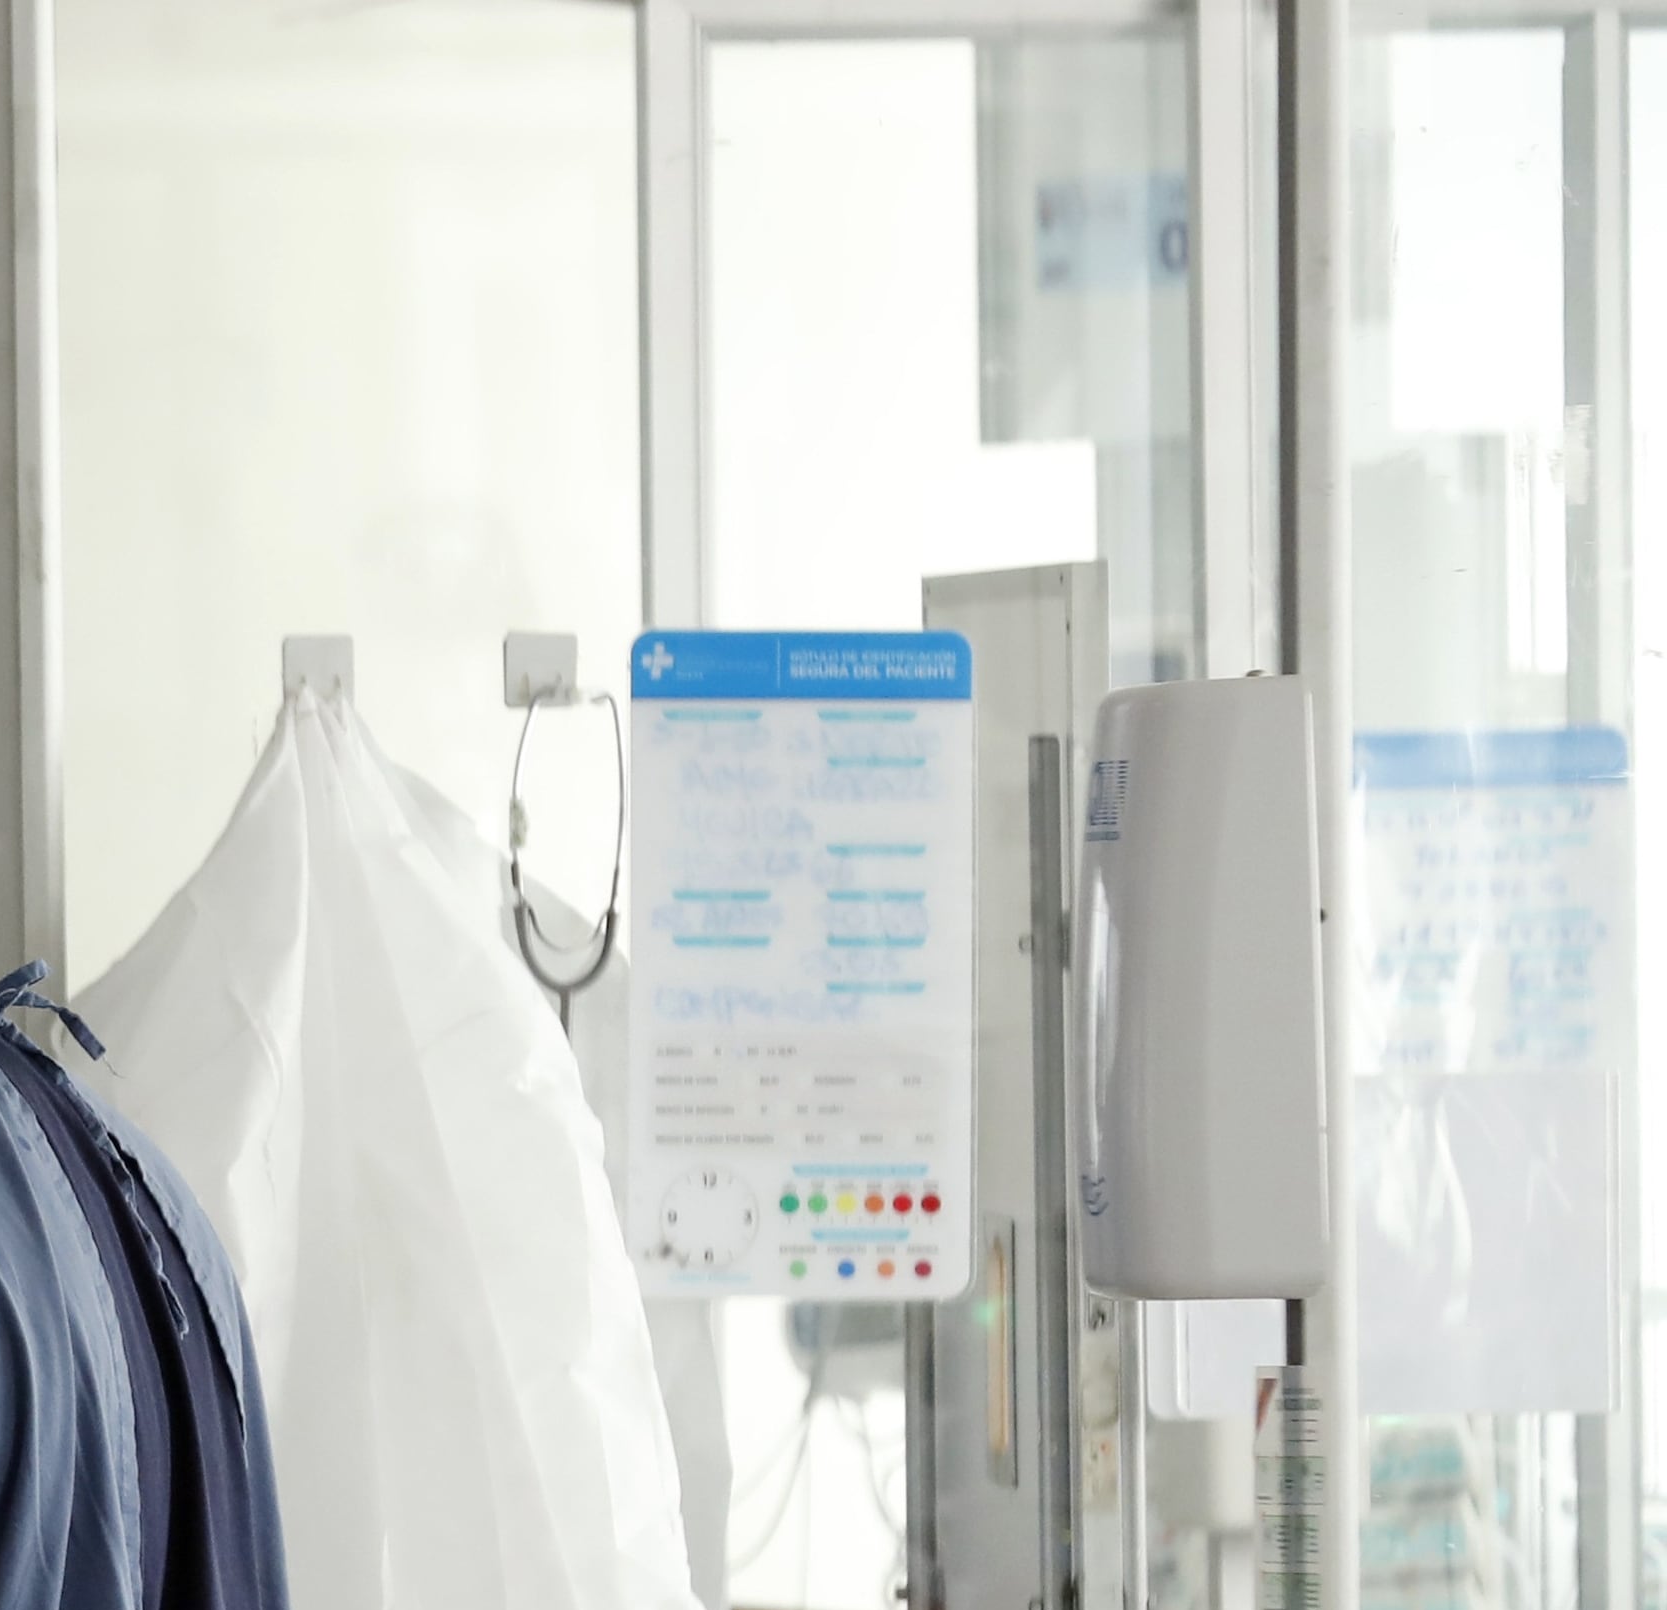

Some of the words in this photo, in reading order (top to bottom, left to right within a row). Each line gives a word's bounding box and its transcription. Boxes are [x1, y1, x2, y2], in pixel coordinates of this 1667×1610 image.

[790, 664, 849, 679] SEGURA
[854, 664, 880, 679] DEL
[886, 664, 955, 679] PACIENTE
